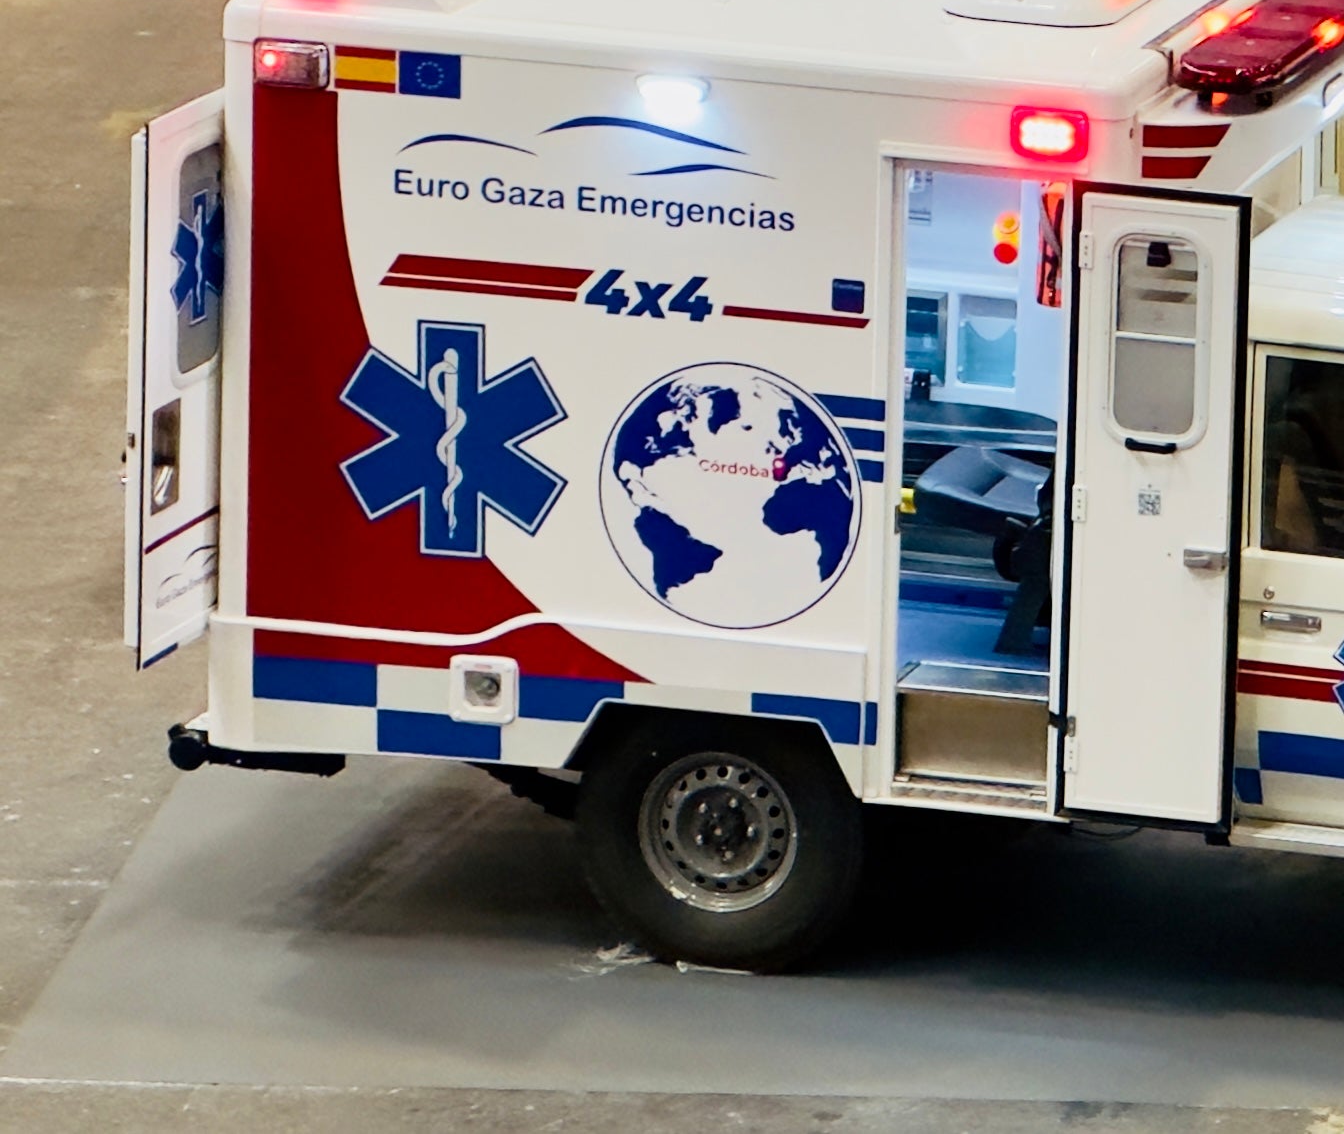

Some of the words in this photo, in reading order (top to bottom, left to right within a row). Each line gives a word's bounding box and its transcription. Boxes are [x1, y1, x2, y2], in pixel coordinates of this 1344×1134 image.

[393, 168, 470, 201] Euro
[481, 177, 566, 210] Gaza
[577, 186, 796, 233] Emergencias
[584, 269, 714, 322] 4x4
[698, 458, 770, 479] Córdoba
